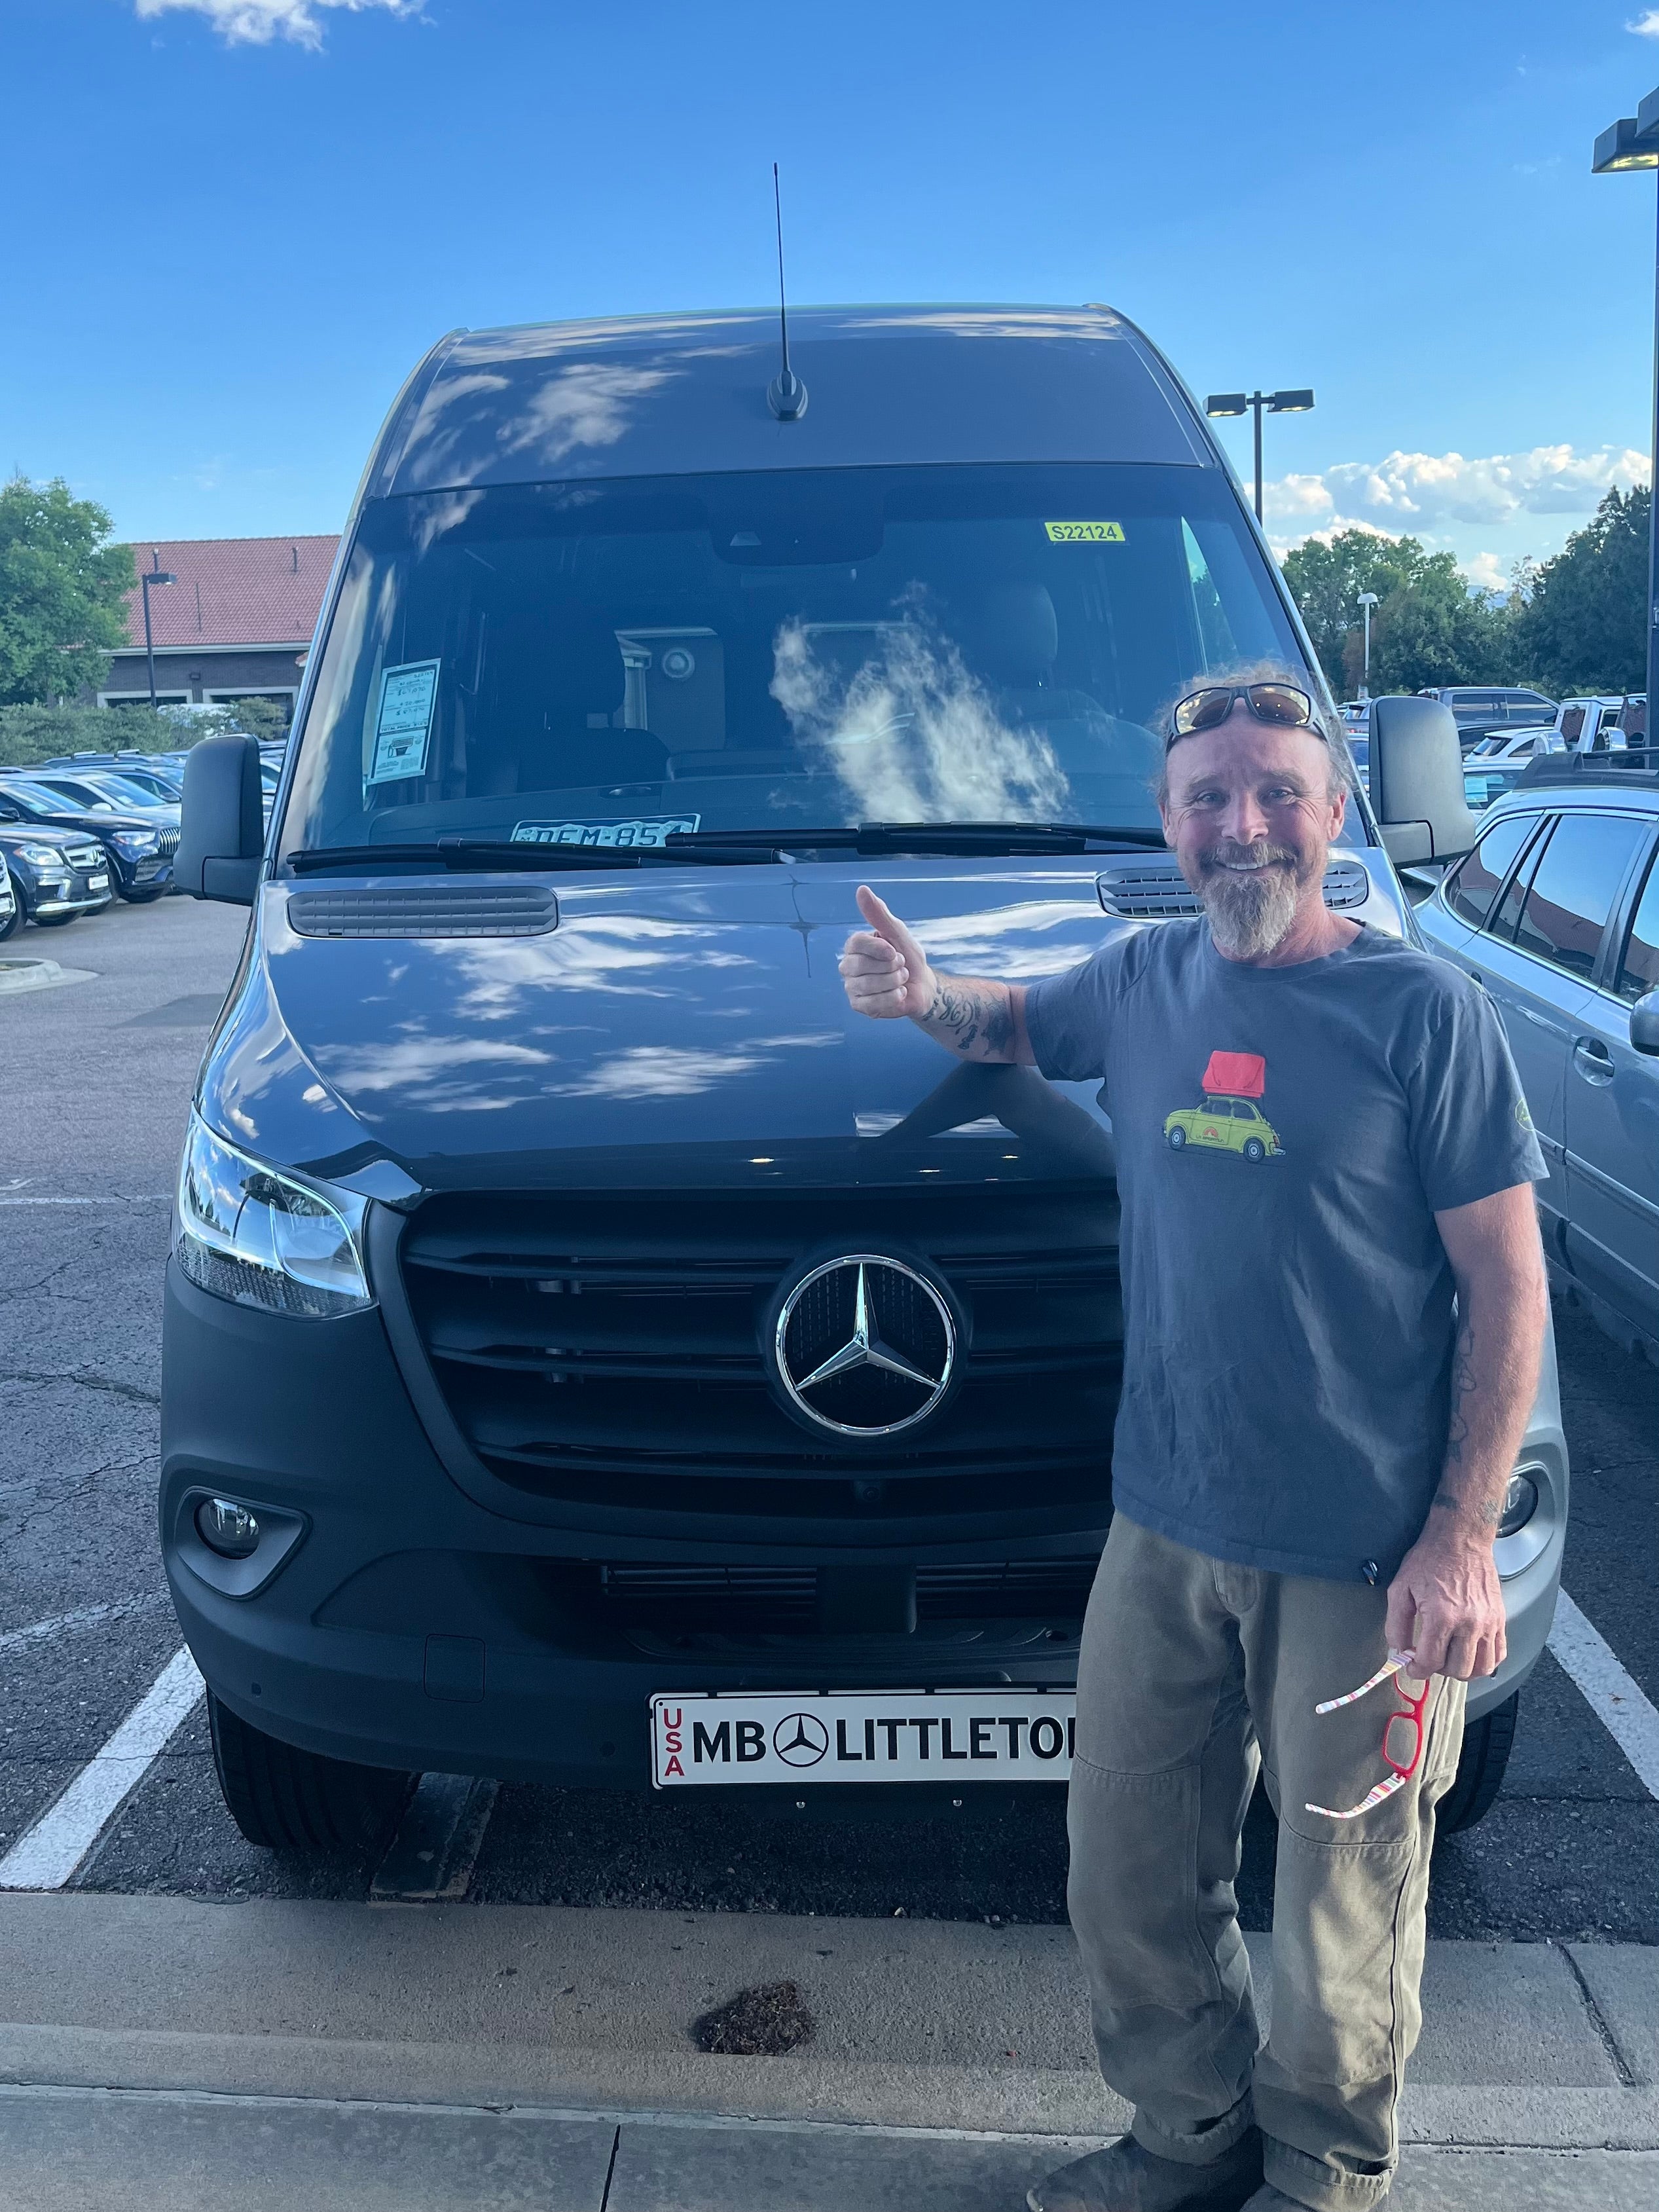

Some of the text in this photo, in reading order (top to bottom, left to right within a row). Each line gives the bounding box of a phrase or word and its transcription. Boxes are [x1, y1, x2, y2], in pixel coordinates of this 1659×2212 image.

[1051, 525, 1118, 540] S22124
[663, 1708, 685, 1777] USA
[693, 1716, 1076, 1763] MB LITTLETO
